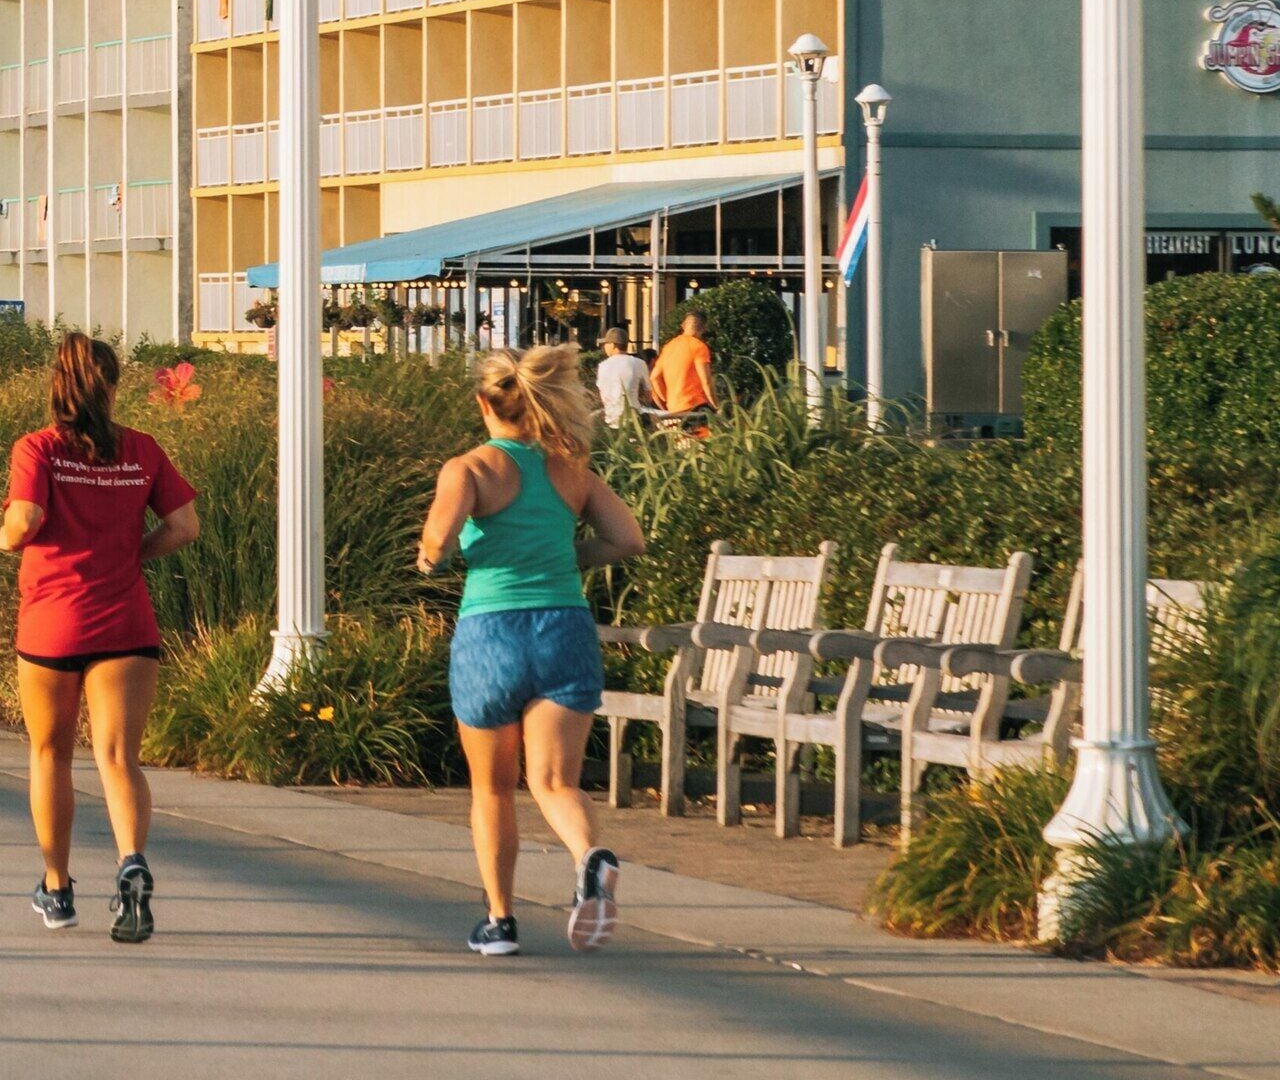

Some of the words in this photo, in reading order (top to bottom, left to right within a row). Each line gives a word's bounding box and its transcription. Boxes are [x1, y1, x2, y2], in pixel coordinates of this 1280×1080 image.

[1146, 235, 1210, 254] BREAKFAST
[62, 459, 90, 472] trophy
[121, 462, 143, 471] dust.
[53, 472, 96, 485] Memories
[97, 476, 112, 486] last
